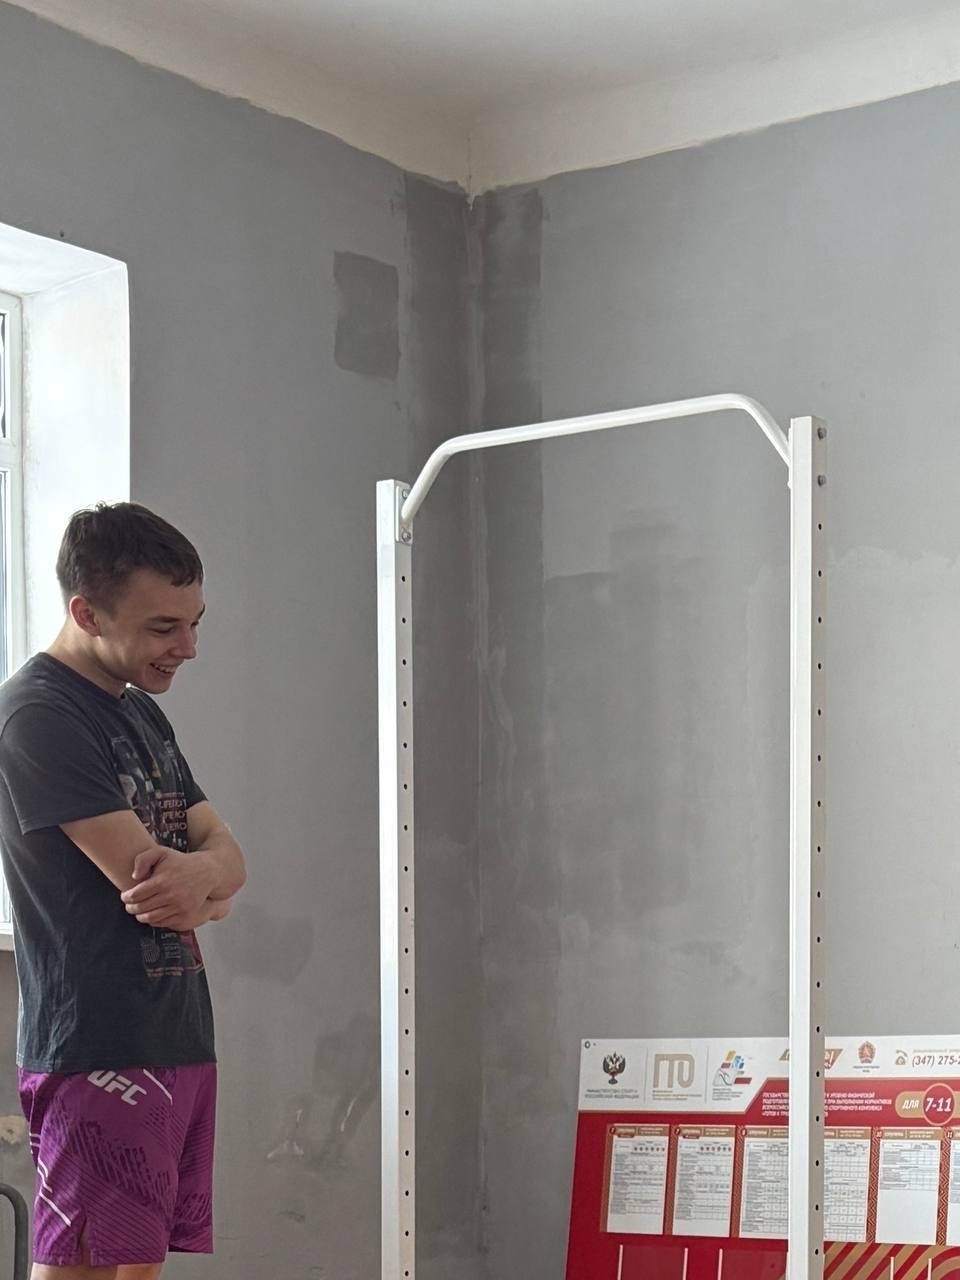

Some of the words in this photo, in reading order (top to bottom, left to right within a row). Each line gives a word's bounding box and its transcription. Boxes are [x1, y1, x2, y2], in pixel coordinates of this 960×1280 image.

[912, 1055, 935, 1068] (347)
[87, 1070, 148, 1106] UFC
[902, 1099, 919, 1110] ДЛЯ
[925, 1097, 952, 1112] 7-11
